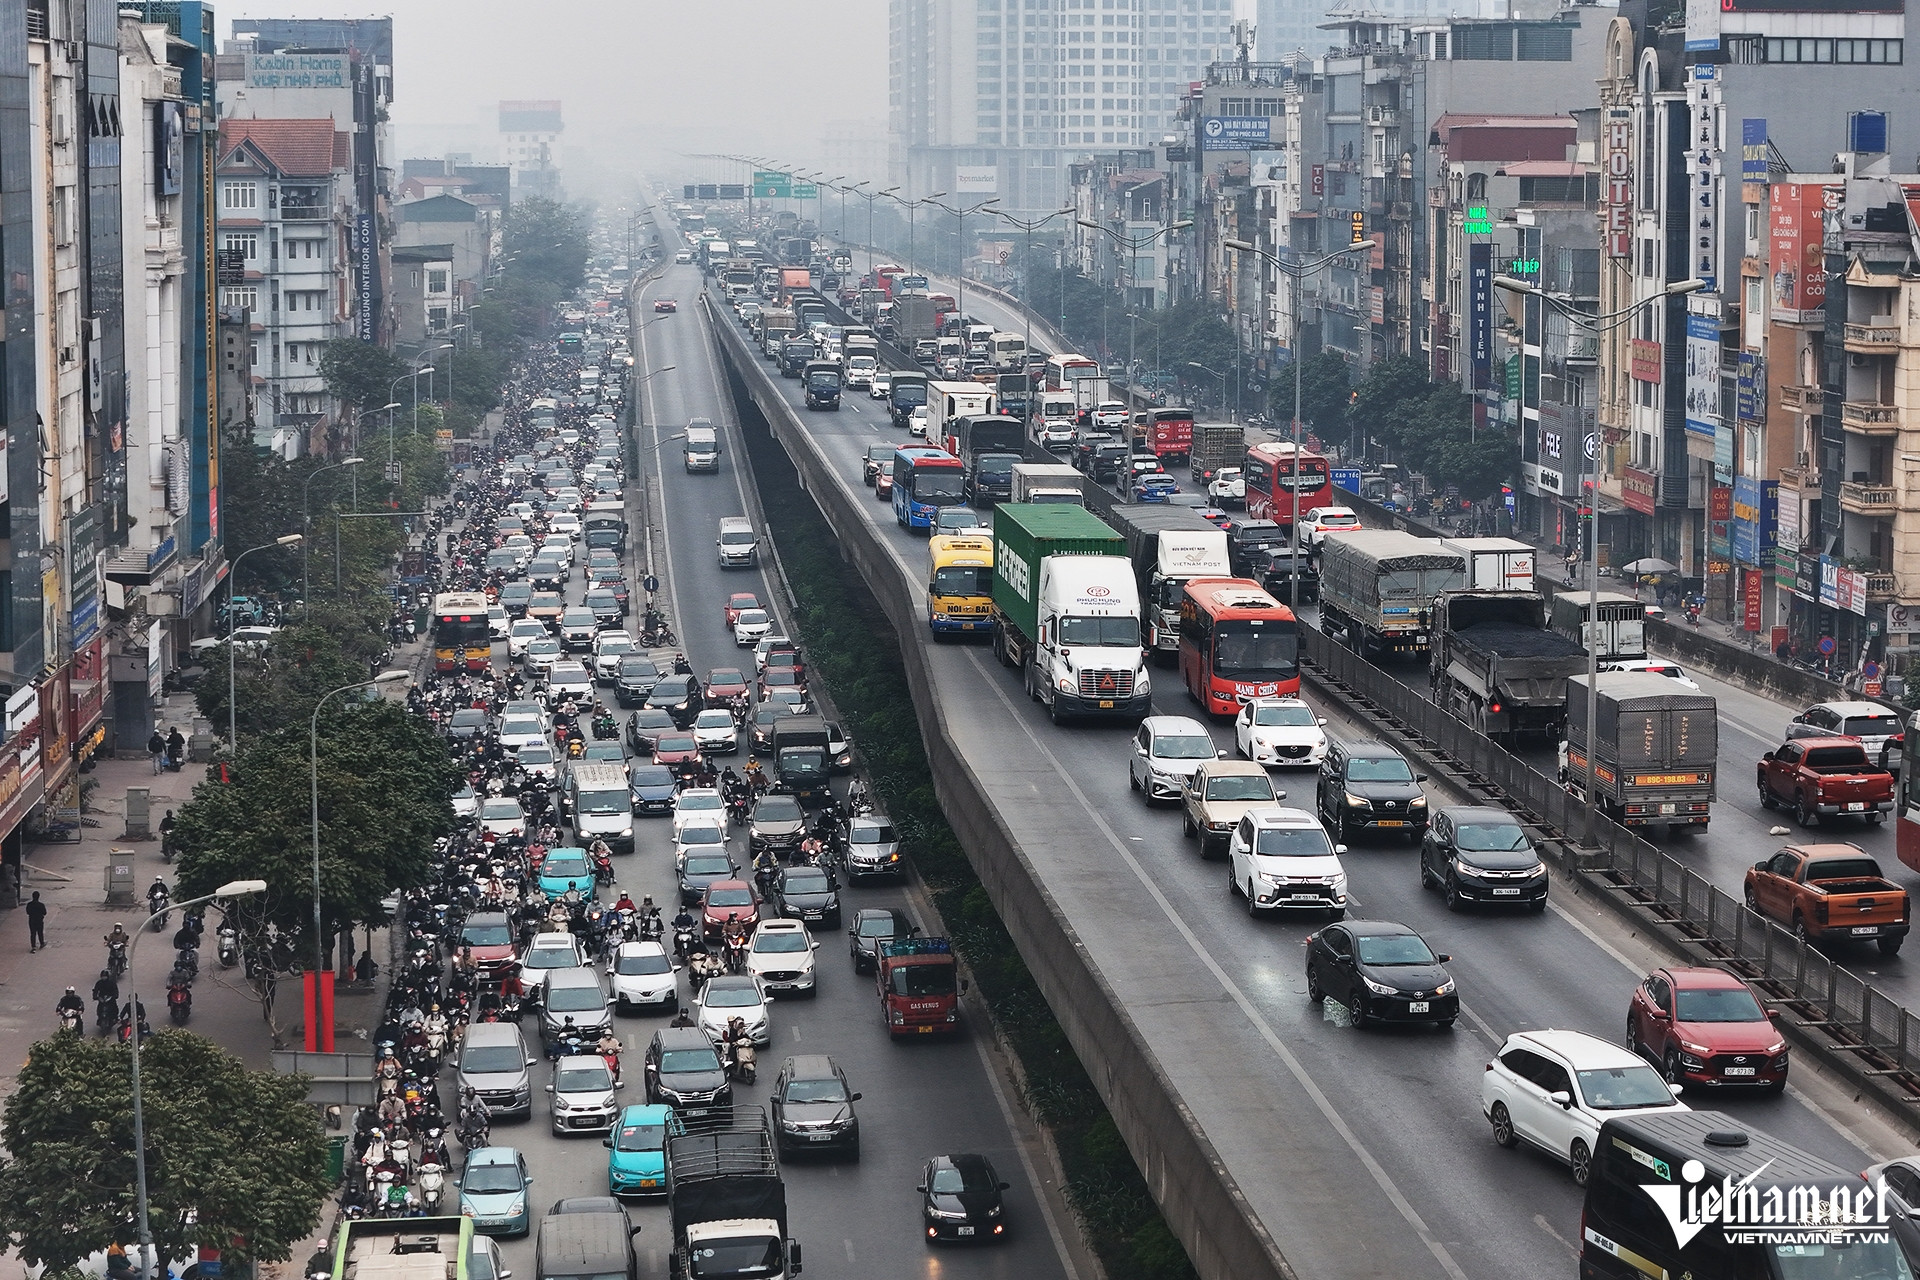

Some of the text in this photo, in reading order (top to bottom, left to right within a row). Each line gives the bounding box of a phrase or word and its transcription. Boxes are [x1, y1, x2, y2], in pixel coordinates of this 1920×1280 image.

[1697, 67, 1713, 76] DNC
[1313, 167, 1323, 193] TCL
[1611, 125, 1628, 257] HOTEL
[1468, 205, 1487, 219] NHÀ
[1464, 219, 1493, 234] THUỐC
[1476, 269, 1485, 359] MINH TIẾN
[998, 538, 1031, 604] EVERGREEN
[947, 605, 989, 614] NOI BAI
[1235, 681, 1278, 696] MẠNH CHIẾN
